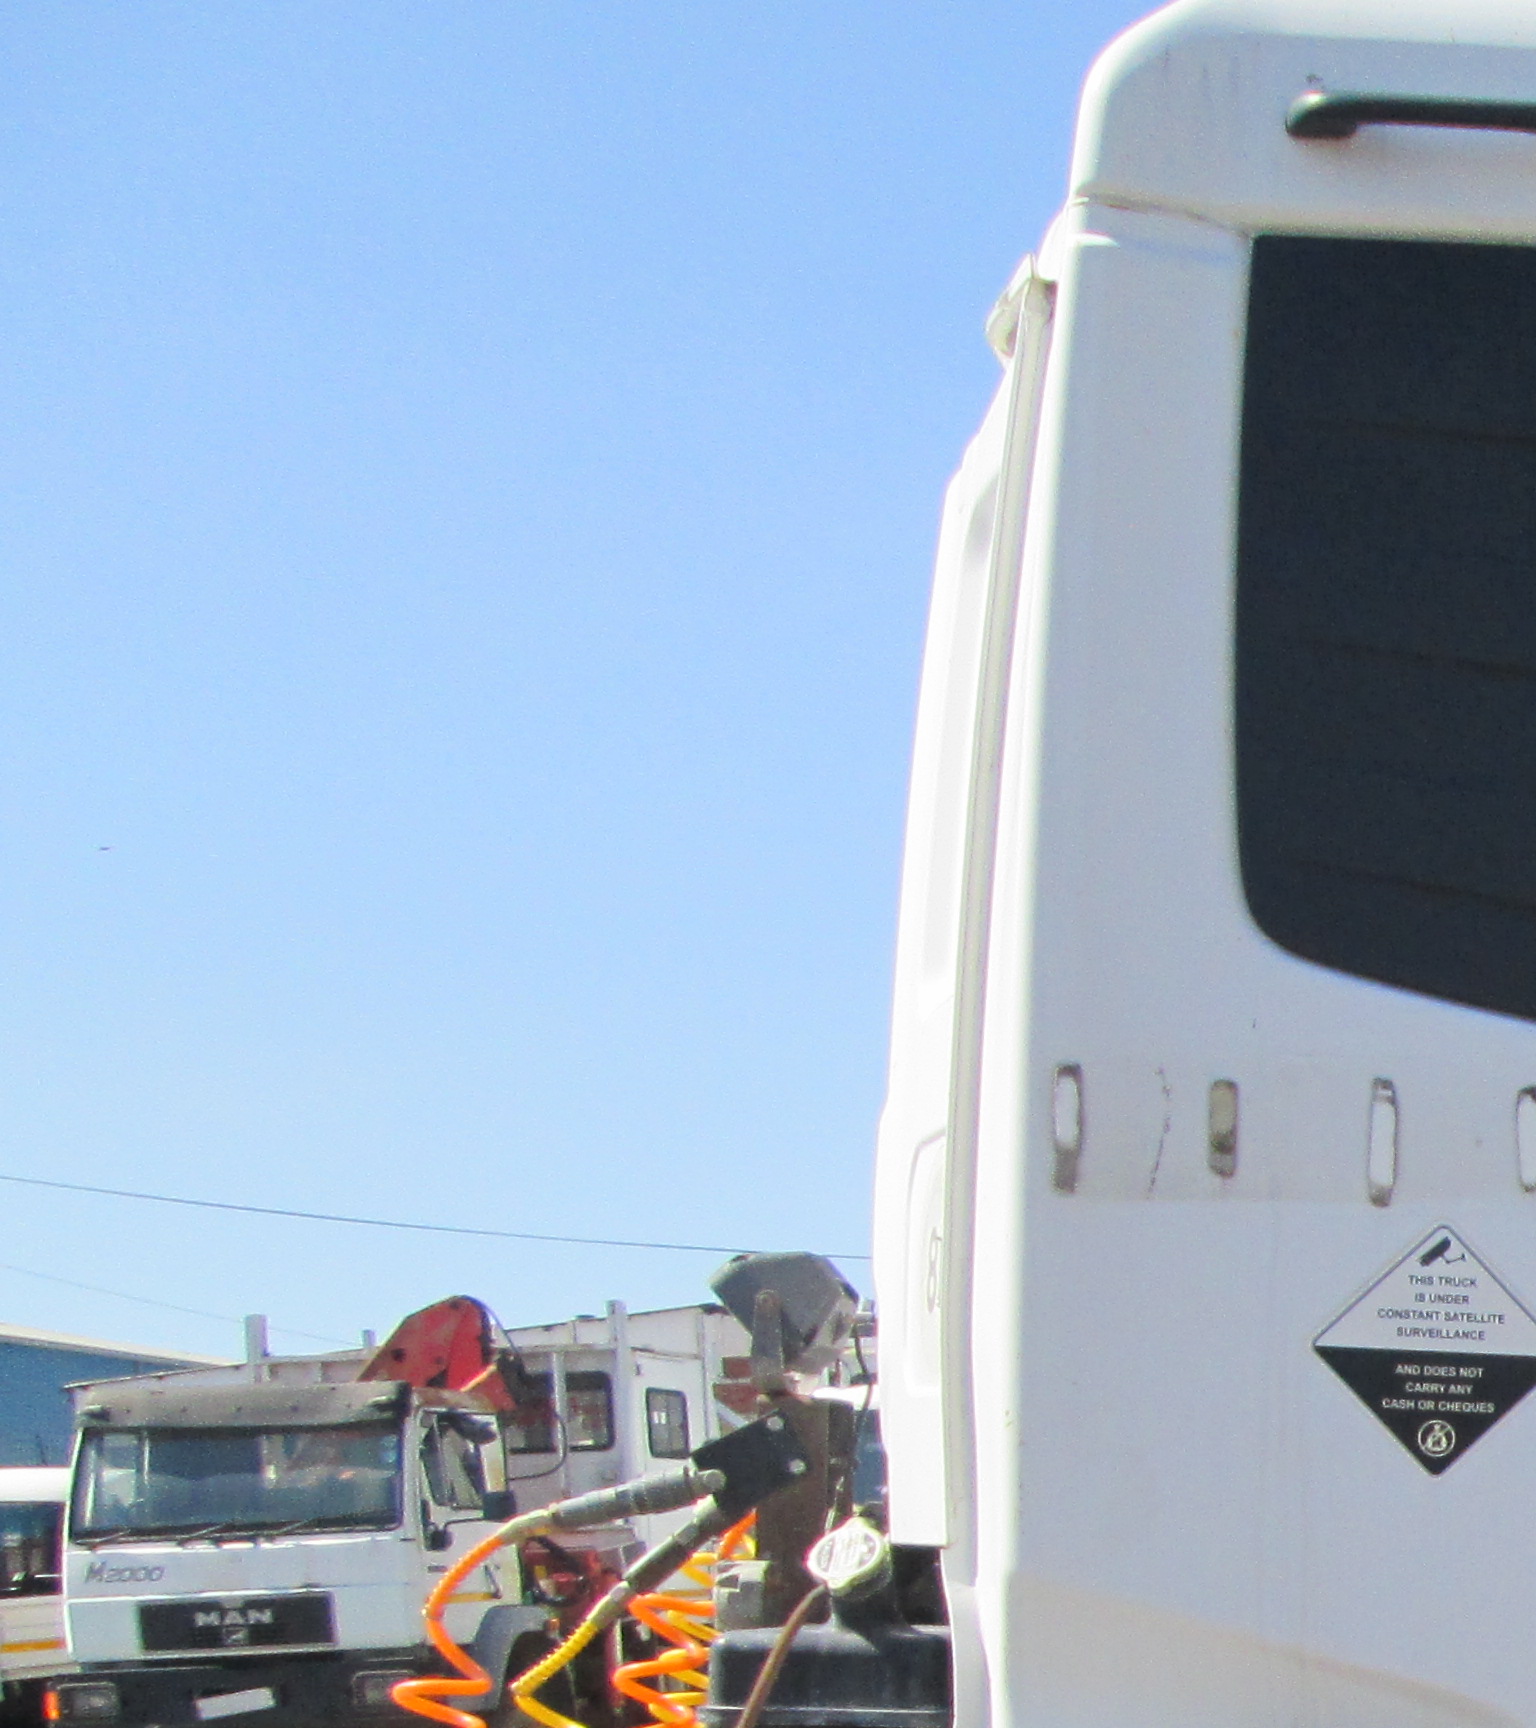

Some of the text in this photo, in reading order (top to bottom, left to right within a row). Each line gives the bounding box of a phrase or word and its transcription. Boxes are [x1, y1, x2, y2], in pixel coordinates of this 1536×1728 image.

[1408, 1274, 1478, 1289] THIS TRUCK
[1415, 1292, 1470, 1305] IS UNDER
[1377, 1307, 1505, 1325] CONSTANT SATELLITE
[1396, 1325, 1486, 1341] SURVEILLANCE
[1395, 1363, 1484, 1379] AND DOES NOT
[1405, 1381, 1474, 1395] CARRY ANY
[1382, 1397, 1496, 1414] CASH OR CHEQUES
[194, 1609, 272, 1626] MAN
